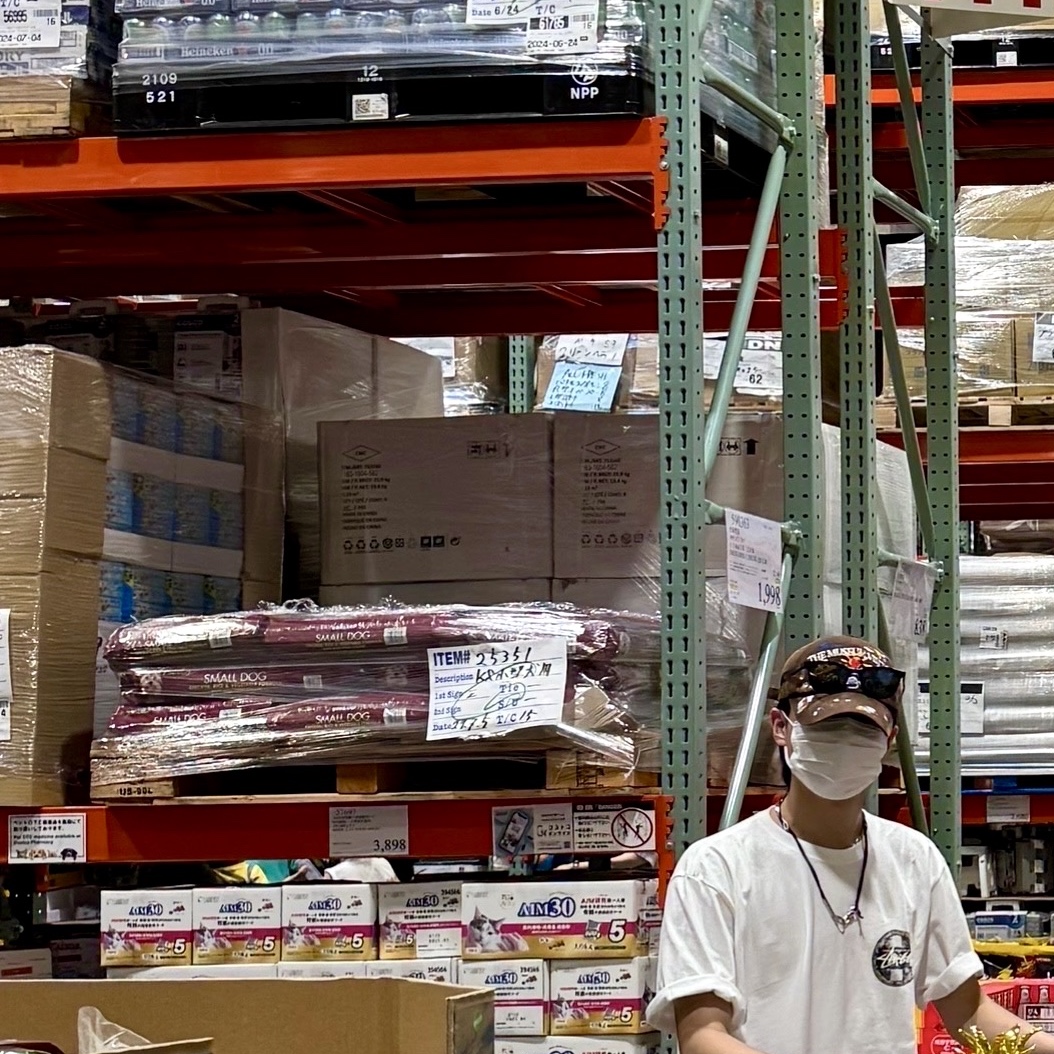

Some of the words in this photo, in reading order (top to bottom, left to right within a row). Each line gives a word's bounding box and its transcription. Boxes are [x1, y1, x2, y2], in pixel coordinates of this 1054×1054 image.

[535, 3, 556, 14] T/C
[361, 65, 379, 78] 12
[142, 72, 177, 86] 2109
[146, 90, 176, 103] 521
[570, 87, 599, 99] NPP
[747, 339, 782, 351] DN
[749, 374, 763, 385] 62
[315, 632, 344, 643] SMALL
[345, 630, 371, 641] DOG
[433, 650, 471, 666] ITEM#
[204, 672, 237, 684] SMALL
[240, 671, 267, 683] DOG
[315, 713, 344, 724] SMALL
[345, 711, 371, 722] DOG
[373, 838, 407, 852] 3,898
[517, 896, 576, 918] AIM30
[607, 918, 628, 944] 5
[173, 938, 187, 955] 5
[263, 936, 276, 953] 5
[351, 933, 364, 950] 5
[619, 1007, 634, 1024] 5
